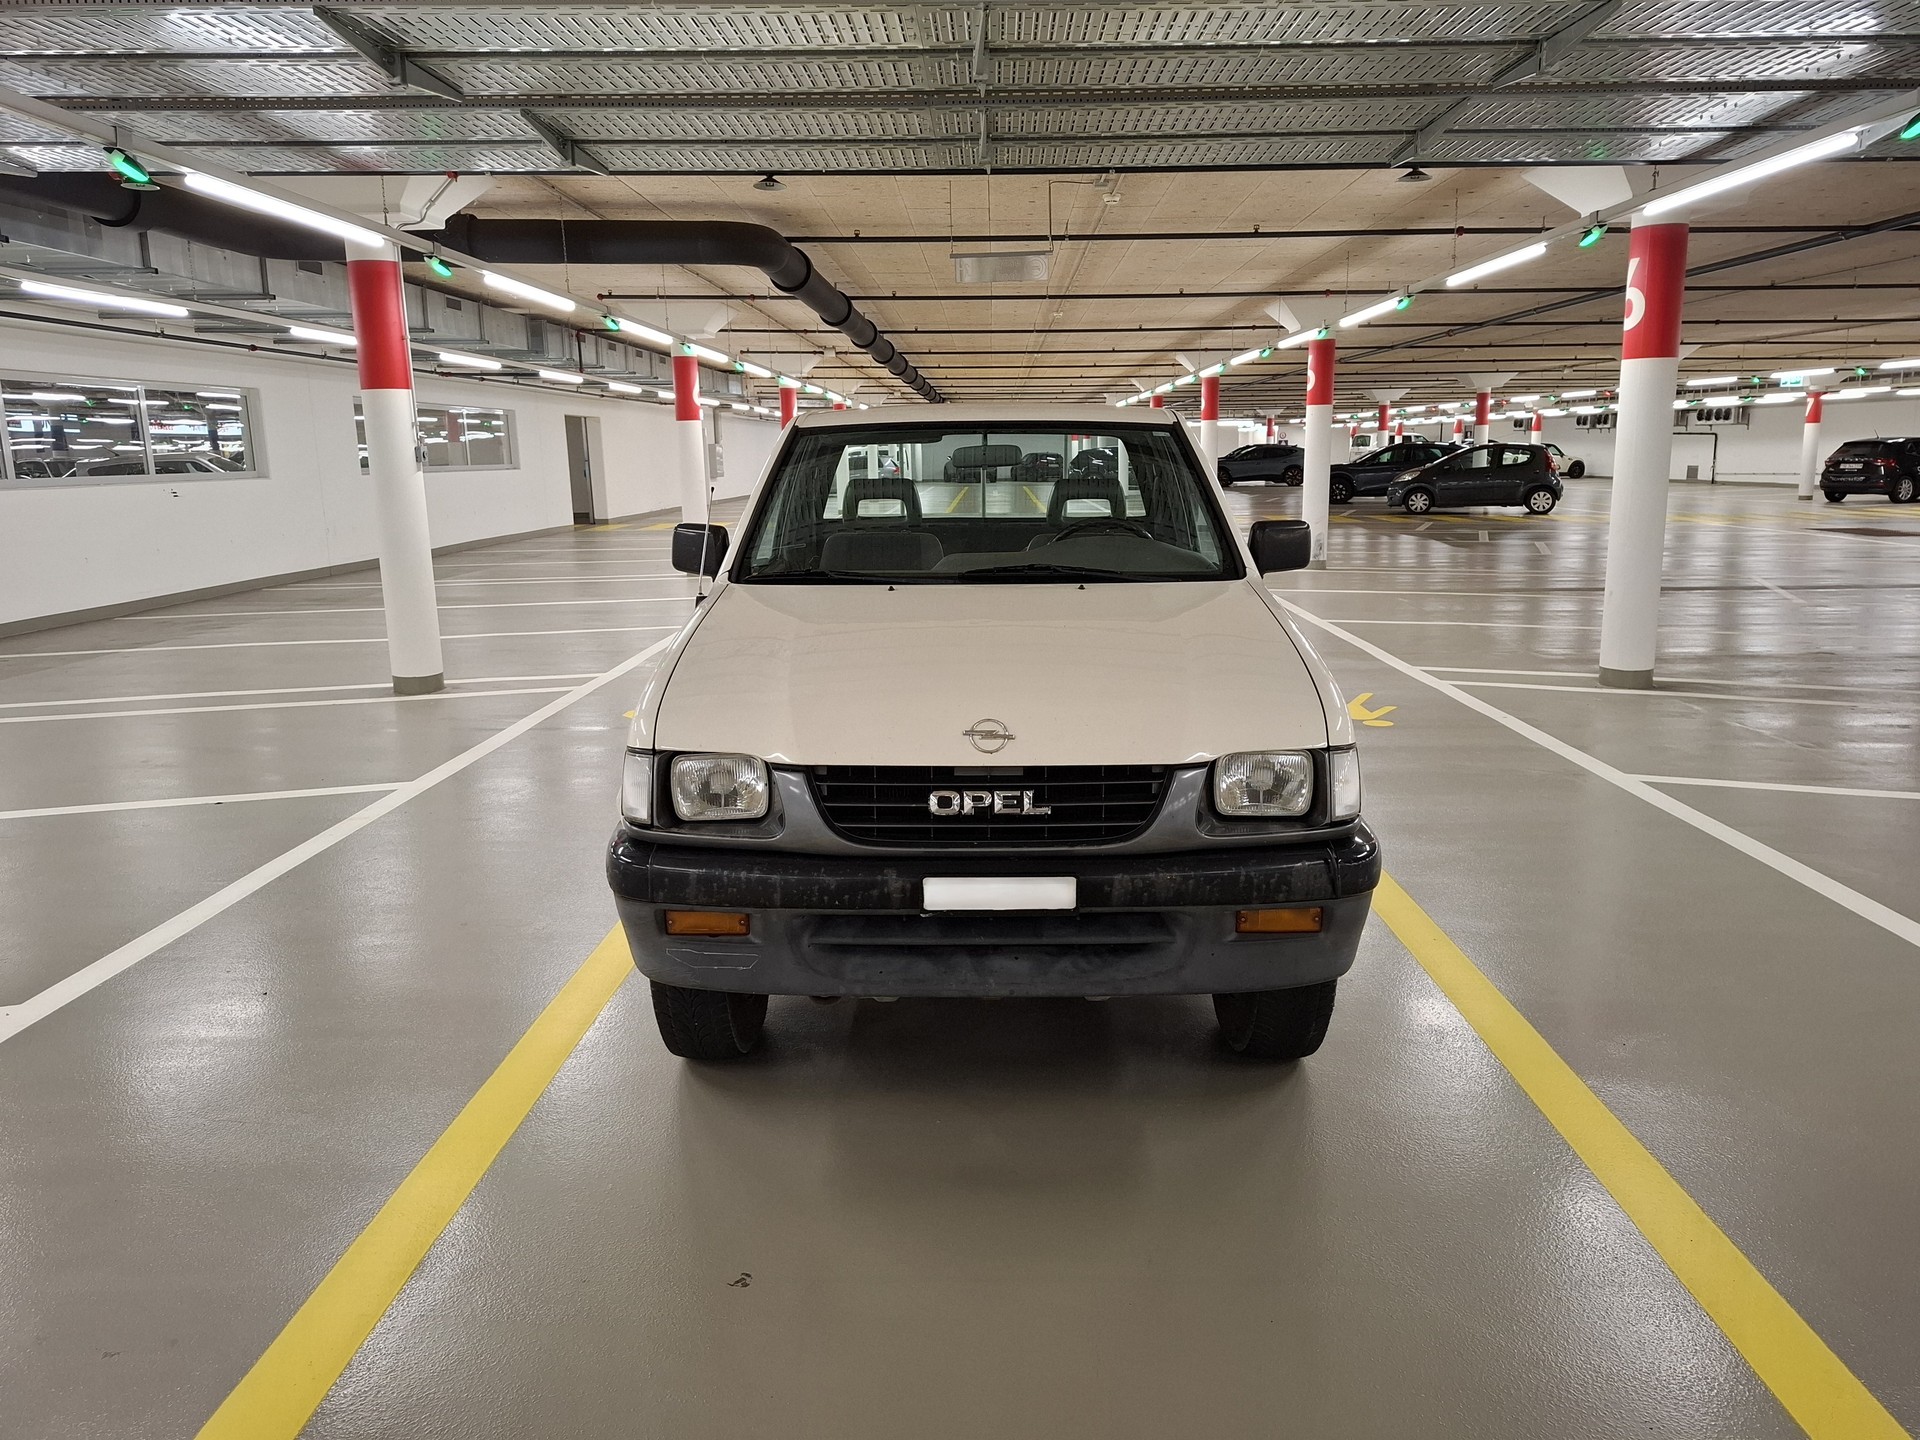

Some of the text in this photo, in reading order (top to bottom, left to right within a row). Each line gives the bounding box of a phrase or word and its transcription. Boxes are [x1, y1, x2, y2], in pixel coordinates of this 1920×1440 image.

[1623, 257, 1646, 331] 6
[1805, 397, 1815, 417] 7
[928, 789, 1052, 816] OPEL
